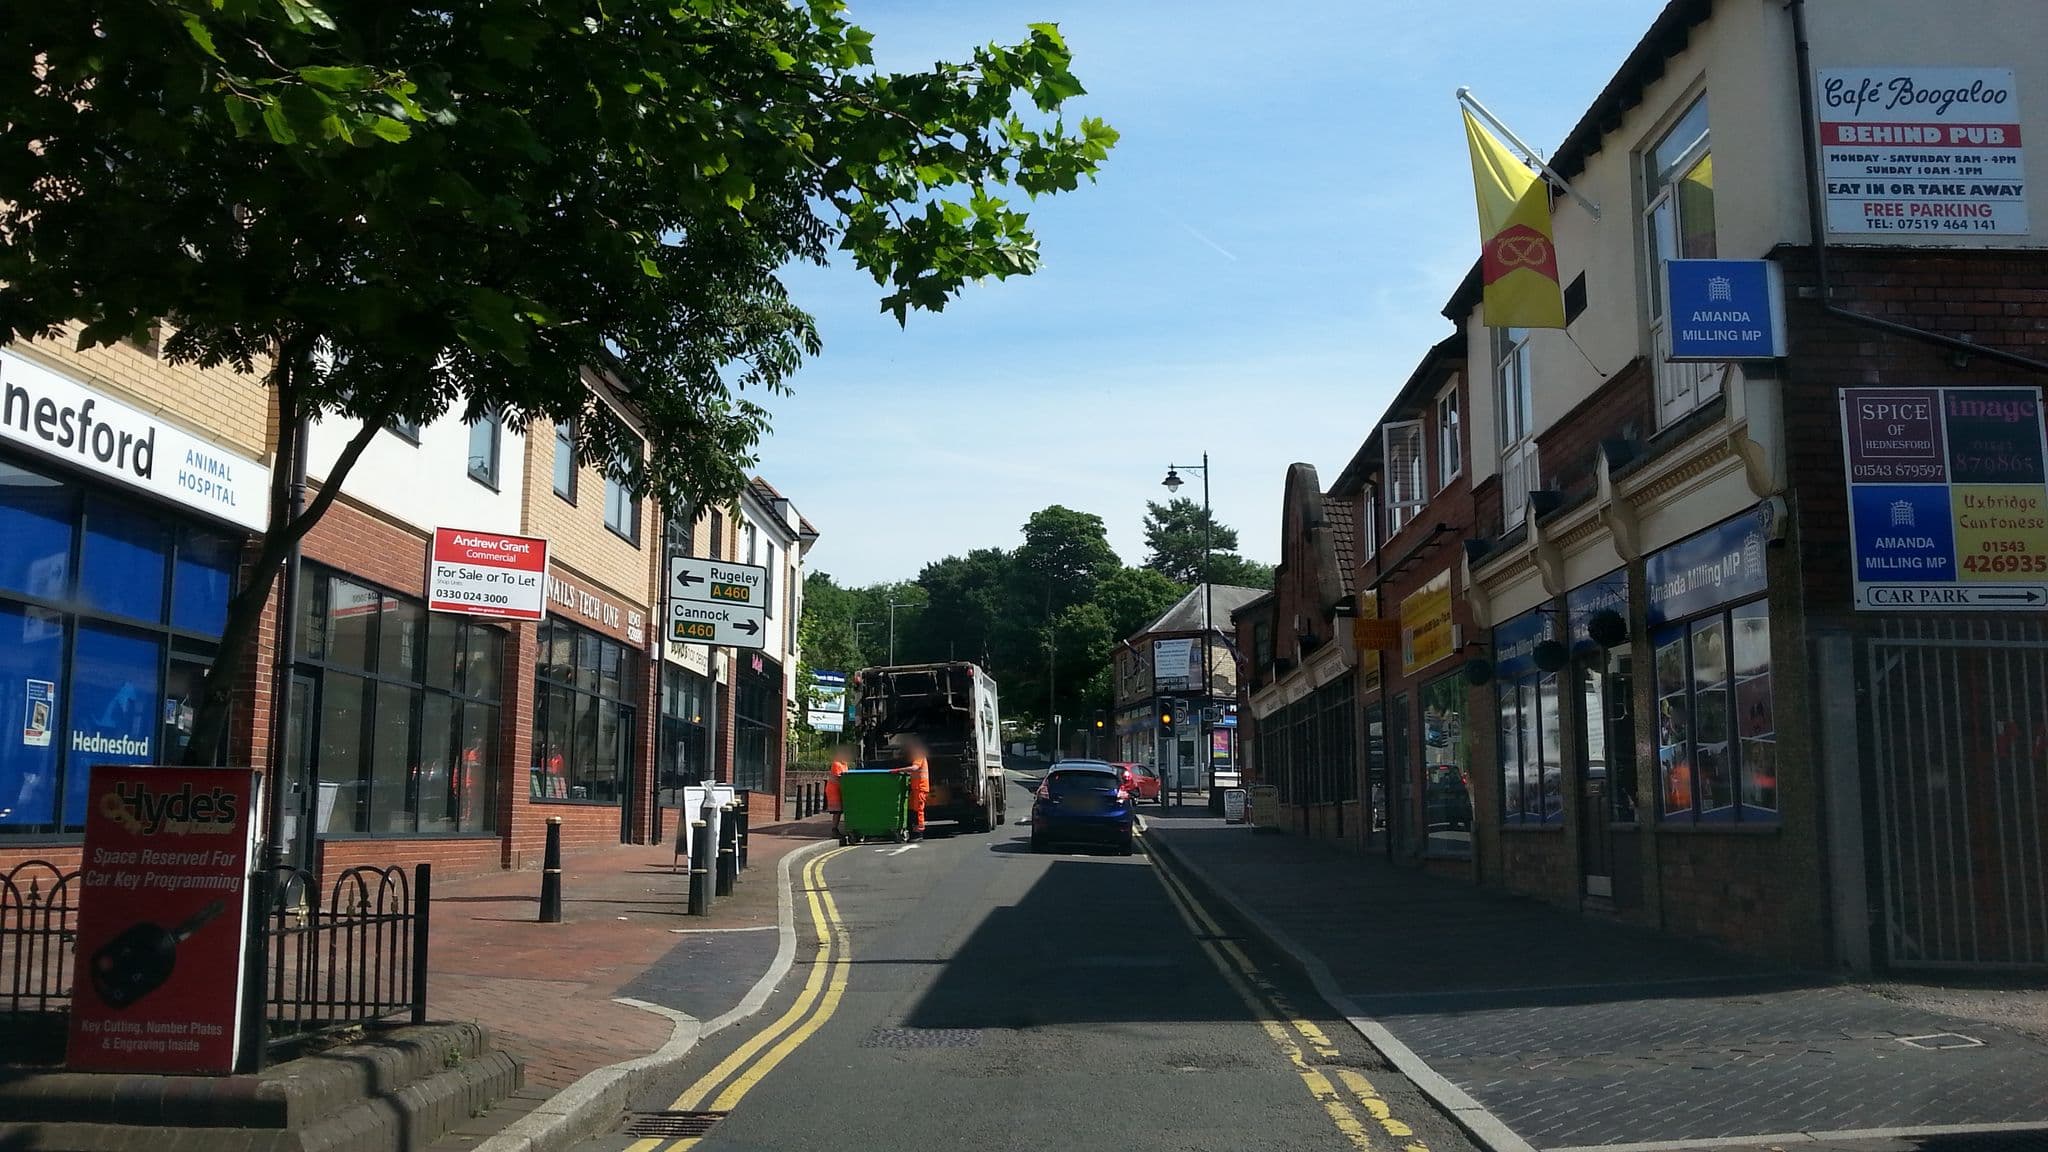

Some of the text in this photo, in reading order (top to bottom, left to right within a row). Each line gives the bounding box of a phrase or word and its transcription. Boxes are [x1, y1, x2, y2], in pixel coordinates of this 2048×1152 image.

[1825, 77, 2007, 116] Café Boogaloo
[1838, 126, 2006, 144] BEHIND PUB
[1830, 154, 1880, 163] MONDAY
[1890, 154, 1950, 163] SATURDAY
[1955, 155, 1981, 163] 8AM
[1991, 155, 2016, 164] 4PM
[1866, 166, 1912, 174] SUNDAY
[1917, 166, 1950, 175] 10AM
[1828, 183, 2023, 196] EAT IN OR TAKE AWAY
[1864, 203, 1993, 218] FREE PARKING
[1866, 218, 1996, 230] TEL: 07519 464 141
[1691, 311, 1751, 322] AMANDA
[1682, 330, 1762, 341] MILLING MP
[0, 360, 155, 480] nesford
[1862, 404, 1929, 420] SPICE
[1887, 424, 1905, 436] OF
[1865, 440, 1931, 449] HEDNESFORD
[186, 449, 232, 482] ANIMAL
[1854, 463, 1944, 478] 01543 879597
[178, 469, 236, 506] HOSPITAL
[1964, 495, 2037, 512] Uxbridge
[1960, 514, 2044, 529] Cantonese
[453, 535, 530, 553] Andrew Grant
[1874, 537, 1935, 549] AMANDA
[1982, 541, 2025, 552] 01543
[466, 549, 516, 563] Commercial
[1865, 557, 1947, 569] MILLING MP
[1963, 555, 2047, 572] 426935
[437, 567, 535, 587] For Sale or To Let
[711, 568, 759, 586] Rugeley
[1650, 552, 1740, 604] Amanda Milling MP
[436, 588, 508, 604] 0330 024 3000
[712, 585, 749, 599] A 460
[1875, 589, 1970, 603] CAR PARK
[547, 576, 619, 629] NAILS TECH ONE
[674, 604, 730, 621] Cannock
[676, 623, 714, 637] A 460
[72, 730, 149, 757] Hednesford
[115, 781, 238, 836] Hyde's
[93, 848, 236, 866] Space Reserved For
[85, 870, 241, 893] Car Key Programming
[81, 1020, 224, 1036] Key Cutting, Number Plates
[102, 1037, 200, 1052] & Engraving Inside
